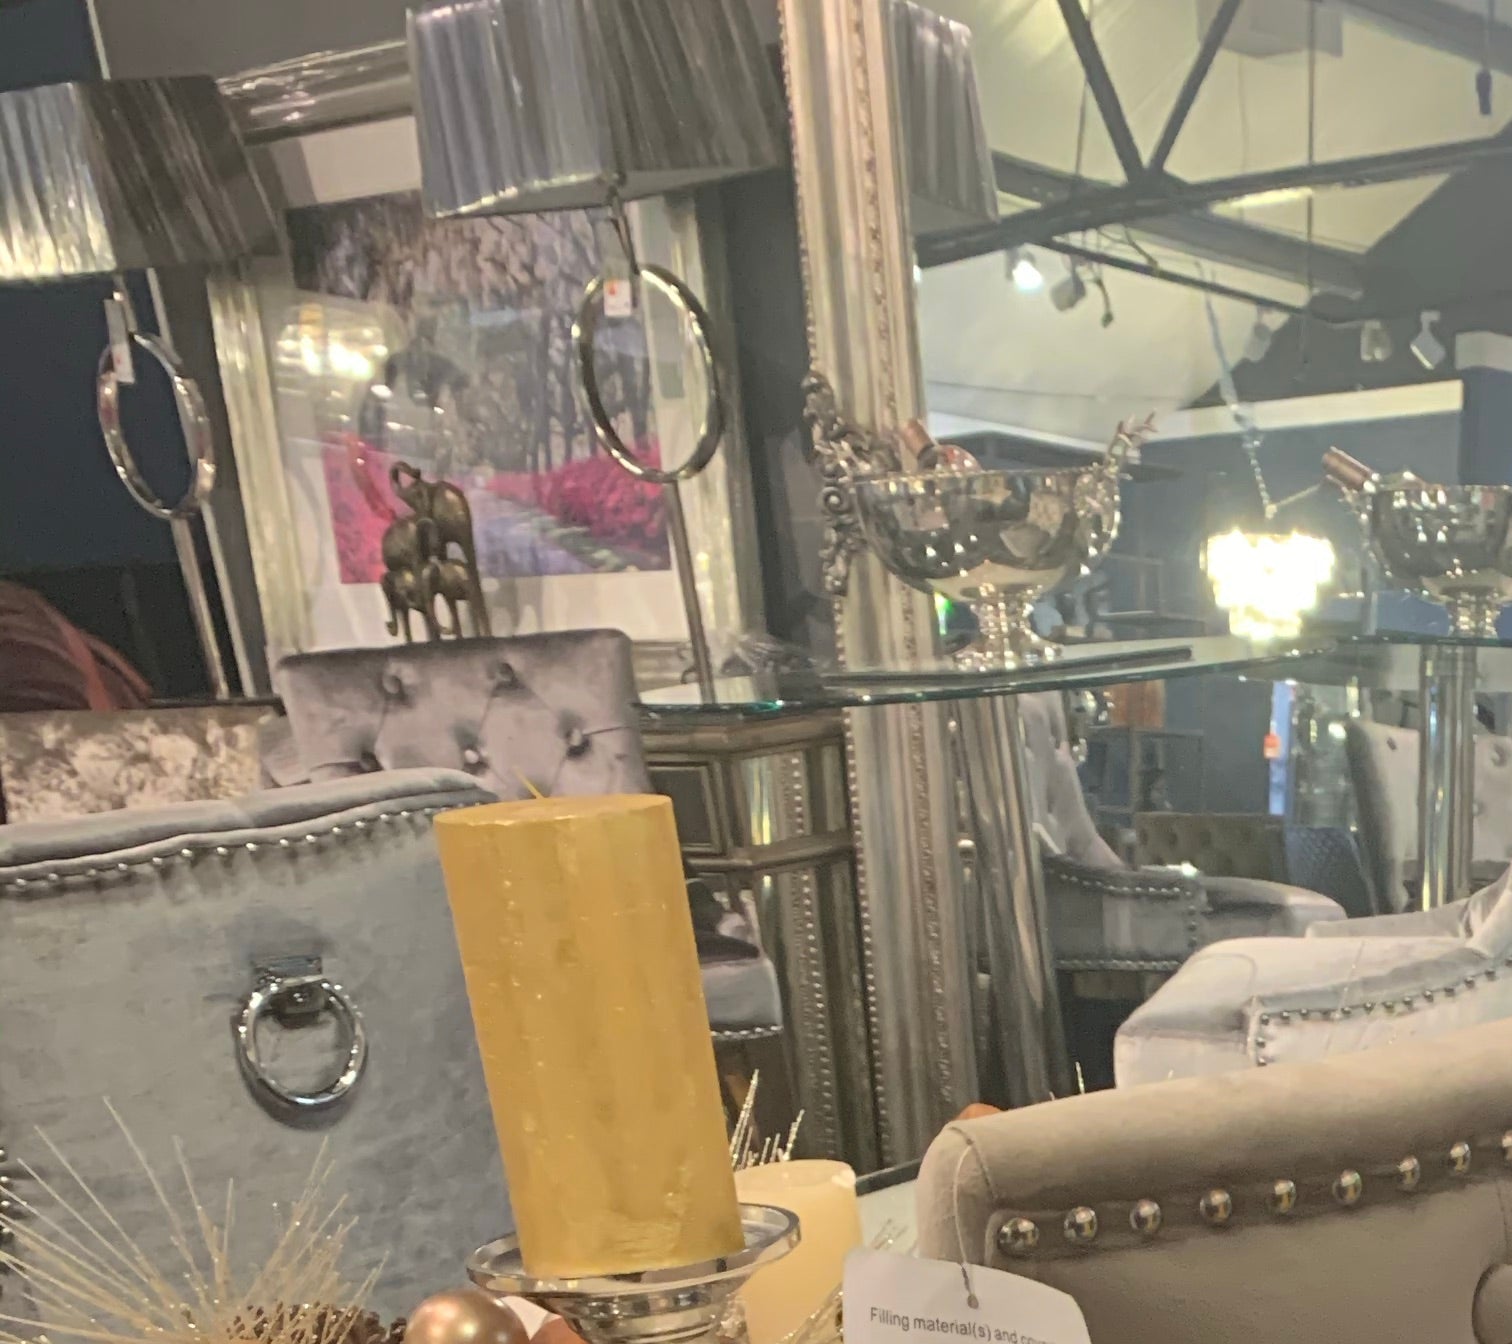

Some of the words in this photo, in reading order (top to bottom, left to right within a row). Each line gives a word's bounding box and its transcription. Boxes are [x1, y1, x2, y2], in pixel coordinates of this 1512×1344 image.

[870, 1307, 909, 1331] Filling
[913, 1316, 991, 1342] material(s)
[994, 1328, 1018, 1344] and
